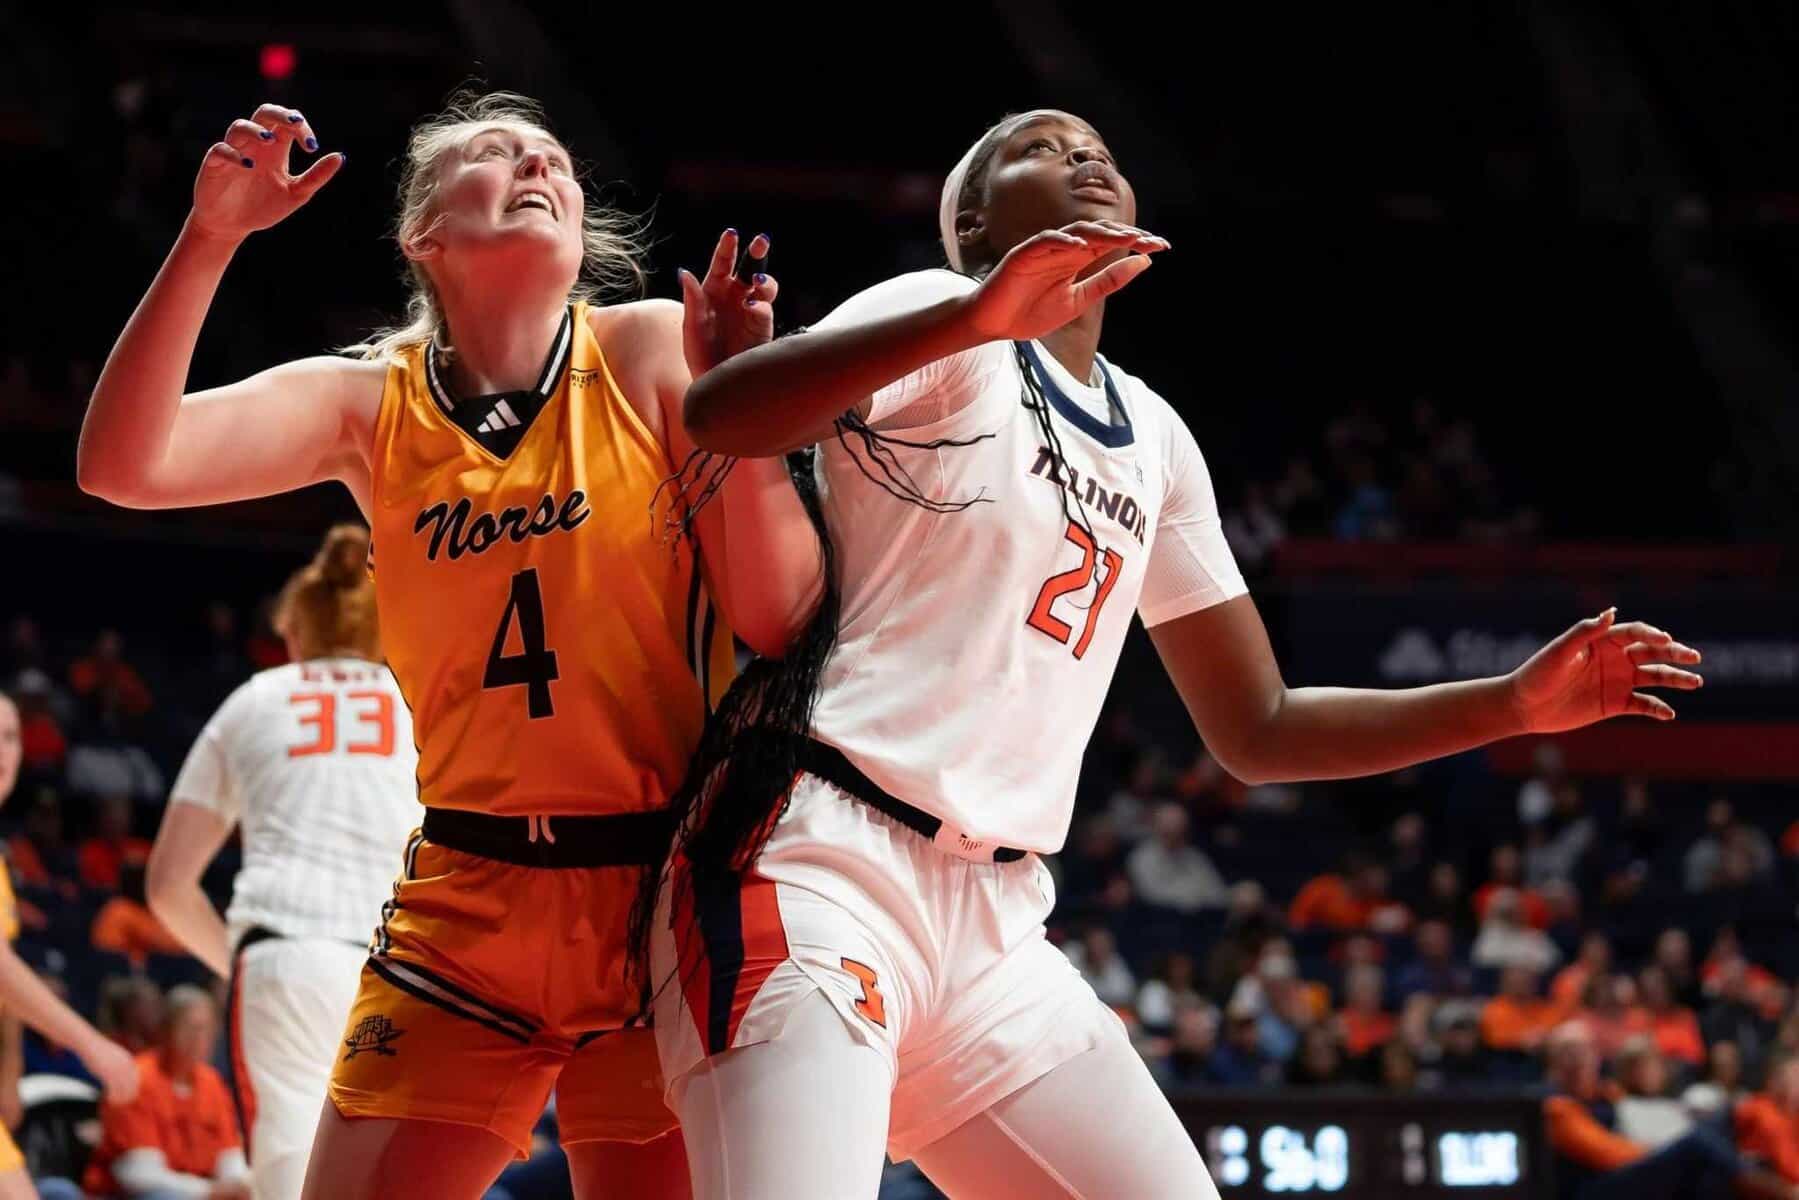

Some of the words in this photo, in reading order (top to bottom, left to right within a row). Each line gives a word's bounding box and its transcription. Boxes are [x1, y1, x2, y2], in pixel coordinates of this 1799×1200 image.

[413, 488, 592, 561] Norse
[482, 567, 561, 720] 4
[1027, 520, 1124, 661] 21
[287, 690, 396, 758] 33
